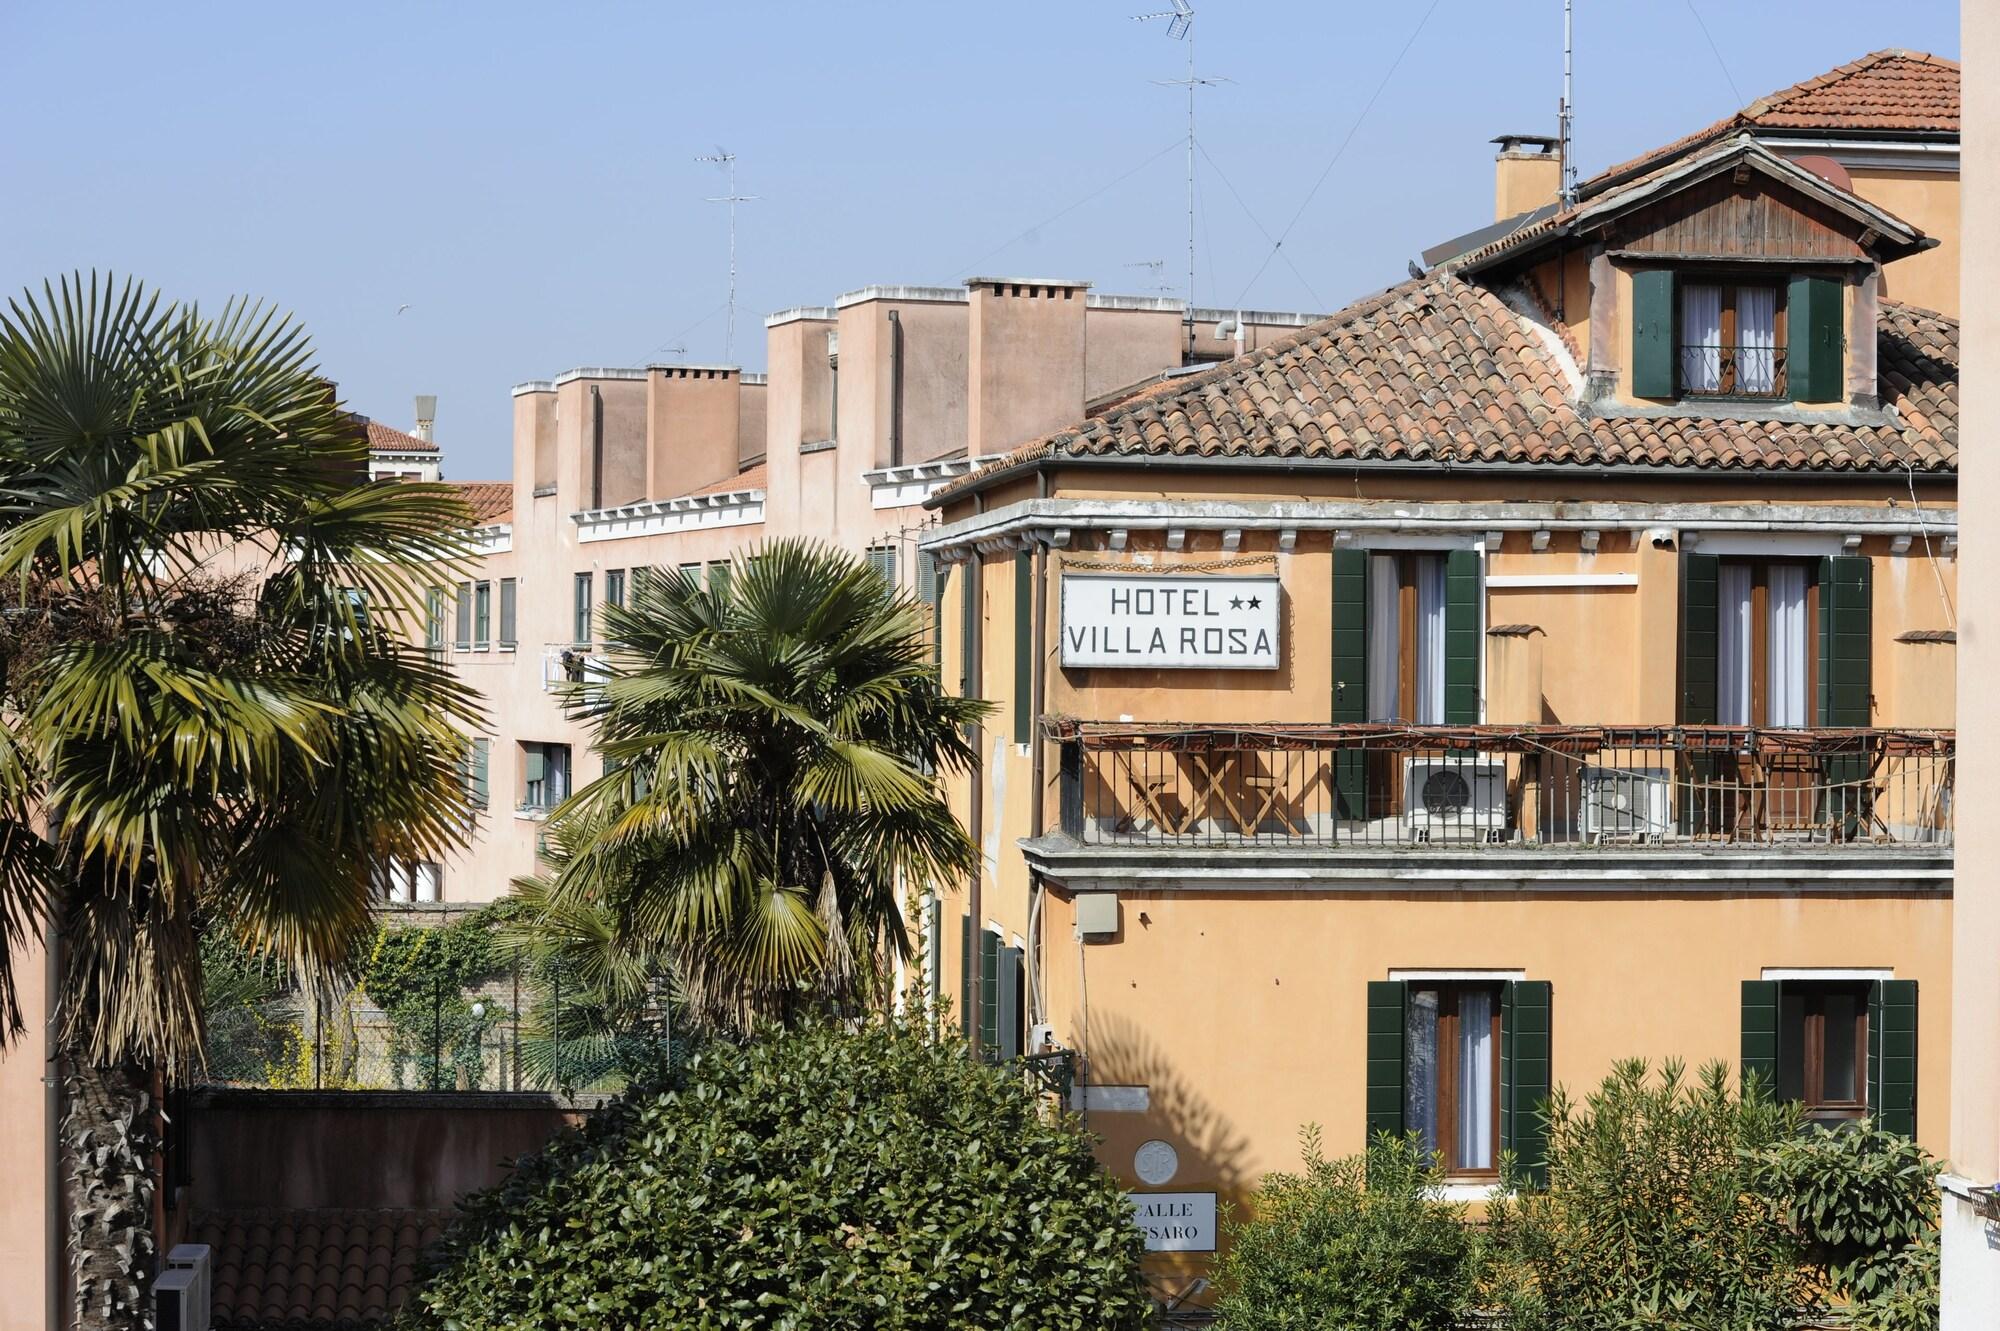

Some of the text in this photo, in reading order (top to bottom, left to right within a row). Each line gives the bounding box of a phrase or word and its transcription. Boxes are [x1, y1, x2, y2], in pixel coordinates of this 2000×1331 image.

[1111, 588, 1220, 616] HOTEL
[1068, 626, 1272, 656] VILLA ROSA
